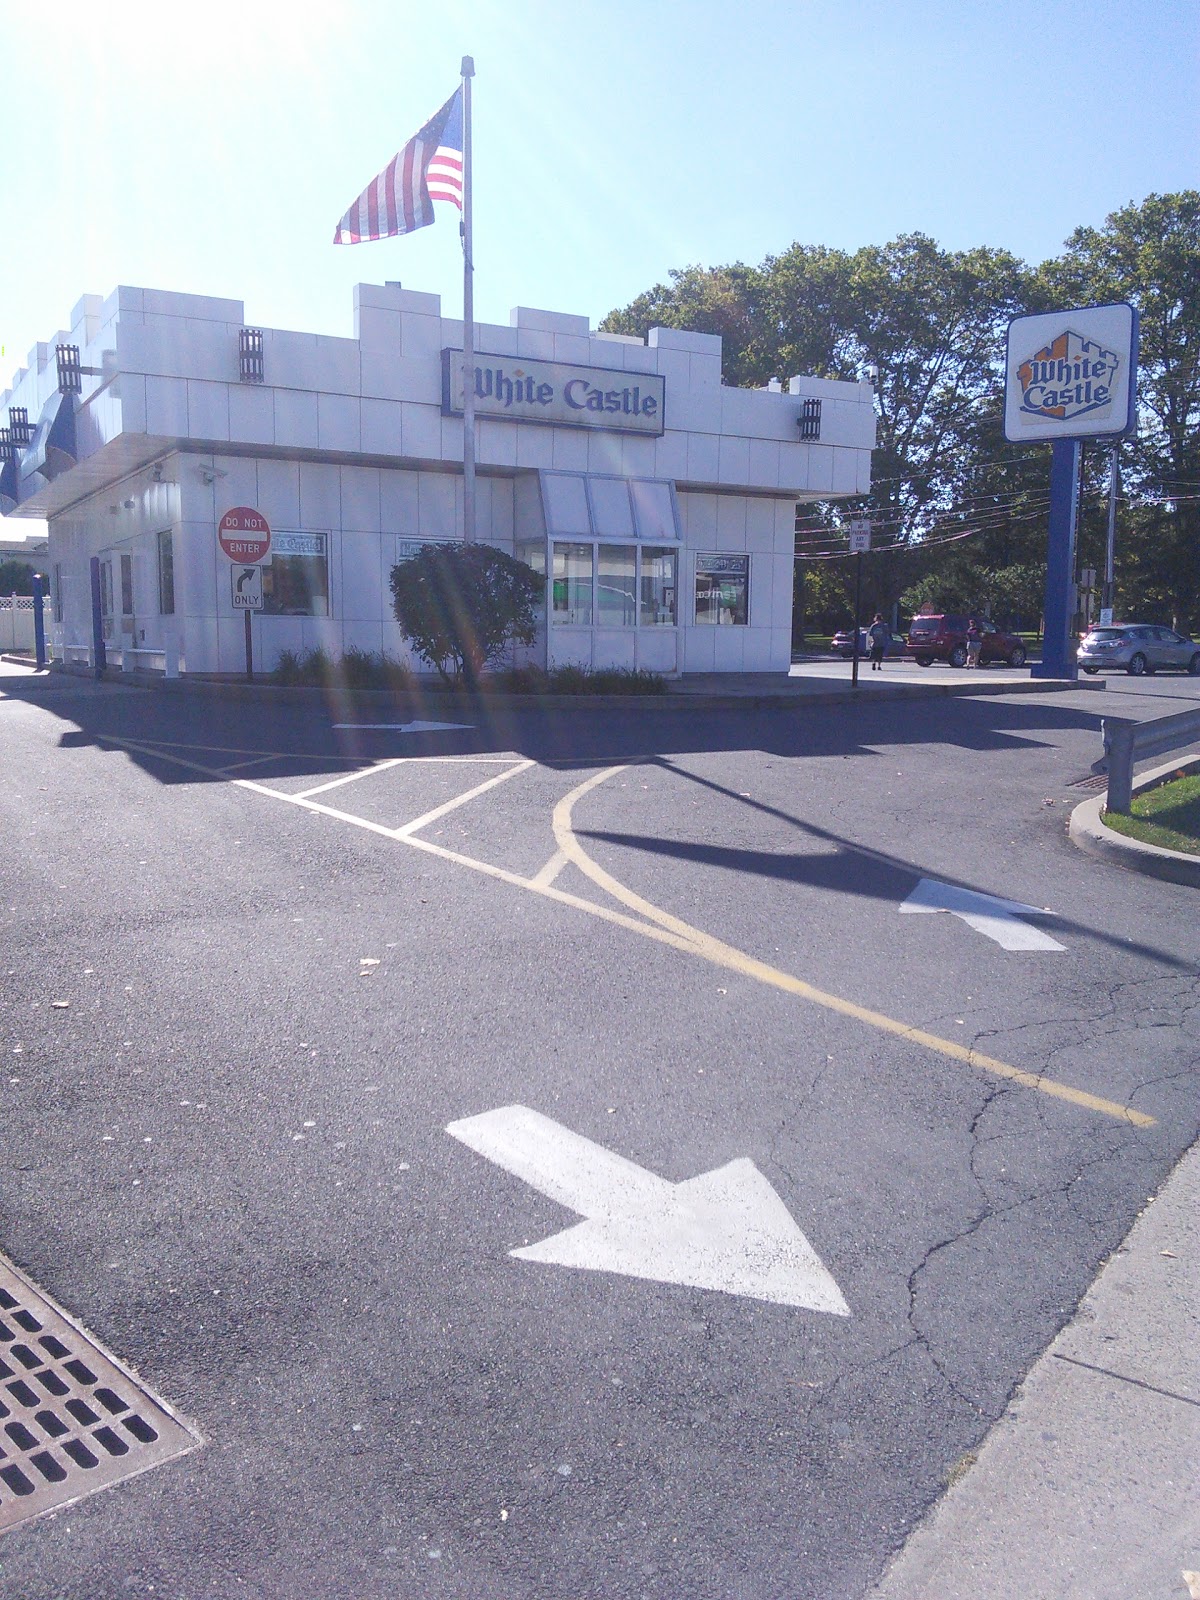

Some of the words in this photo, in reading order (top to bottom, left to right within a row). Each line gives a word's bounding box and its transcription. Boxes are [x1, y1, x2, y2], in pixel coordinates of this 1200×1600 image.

[1029, 355, 1107, 386] White
[461, 366, 554, 408] White
[563, 378, 658, 417] Castle
[1023, 381, 1109, 409] Castle
[225, 517, 239, 527] DO
[244, 518, 263, 528] NOT
[229, 542, 260, 553] ENTER
[234, 595, 259, 605] ONLY
